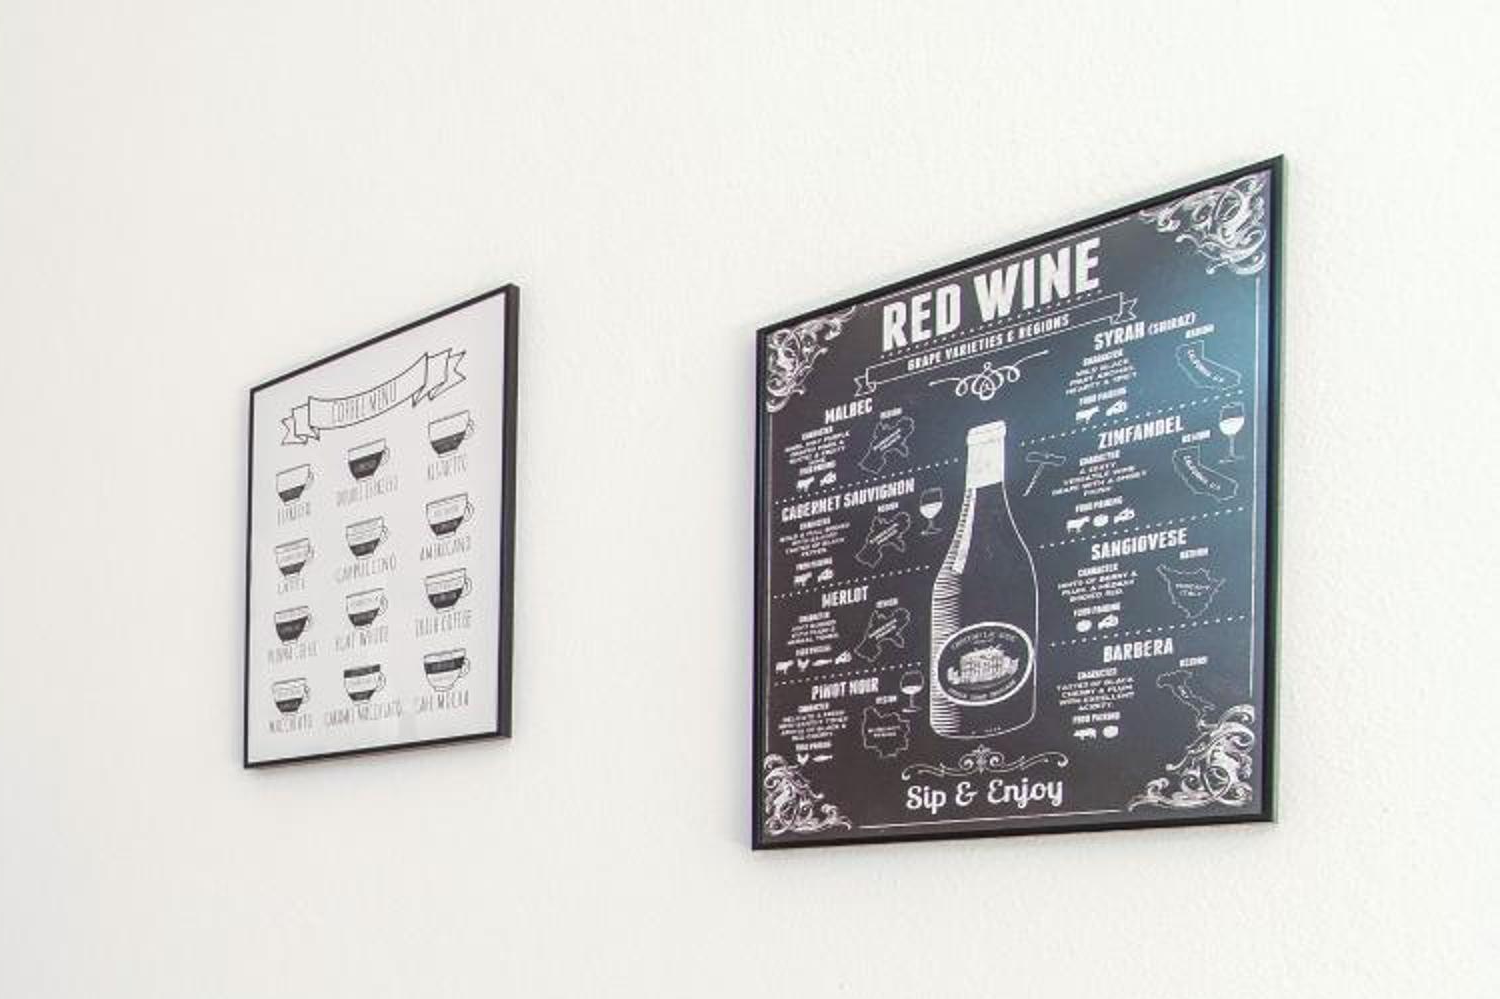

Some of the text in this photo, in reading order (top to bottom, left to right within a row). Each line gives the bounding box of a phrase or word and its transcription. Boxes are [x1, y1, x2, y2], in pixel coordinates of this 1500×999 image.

[883, 237, 1100, 351] RED WINE
[907, 350, 941, 371] GRAPE
[946, 334, 1003, 360] VARIETIES
[1019, 313, 1069, 339] REGIONS
[1094, 321, 1145, 350] SYRAH
[825, 397, 873, 424] MALBEC
[1098, 415, 1184, 450] ZINFANDEL
[781, 477, 915, 522] CABERNET SAUVIGNON
[1091, 527, 1188, 560] SANGIOVESE
[821, 585, 869, 608] MERLOT
[1103, 637, 1174, 663] BARBERA
[811, 677, 879, 701] PINOT NOIR
[906, 777, 1063, 814] Sip & Enjoy
